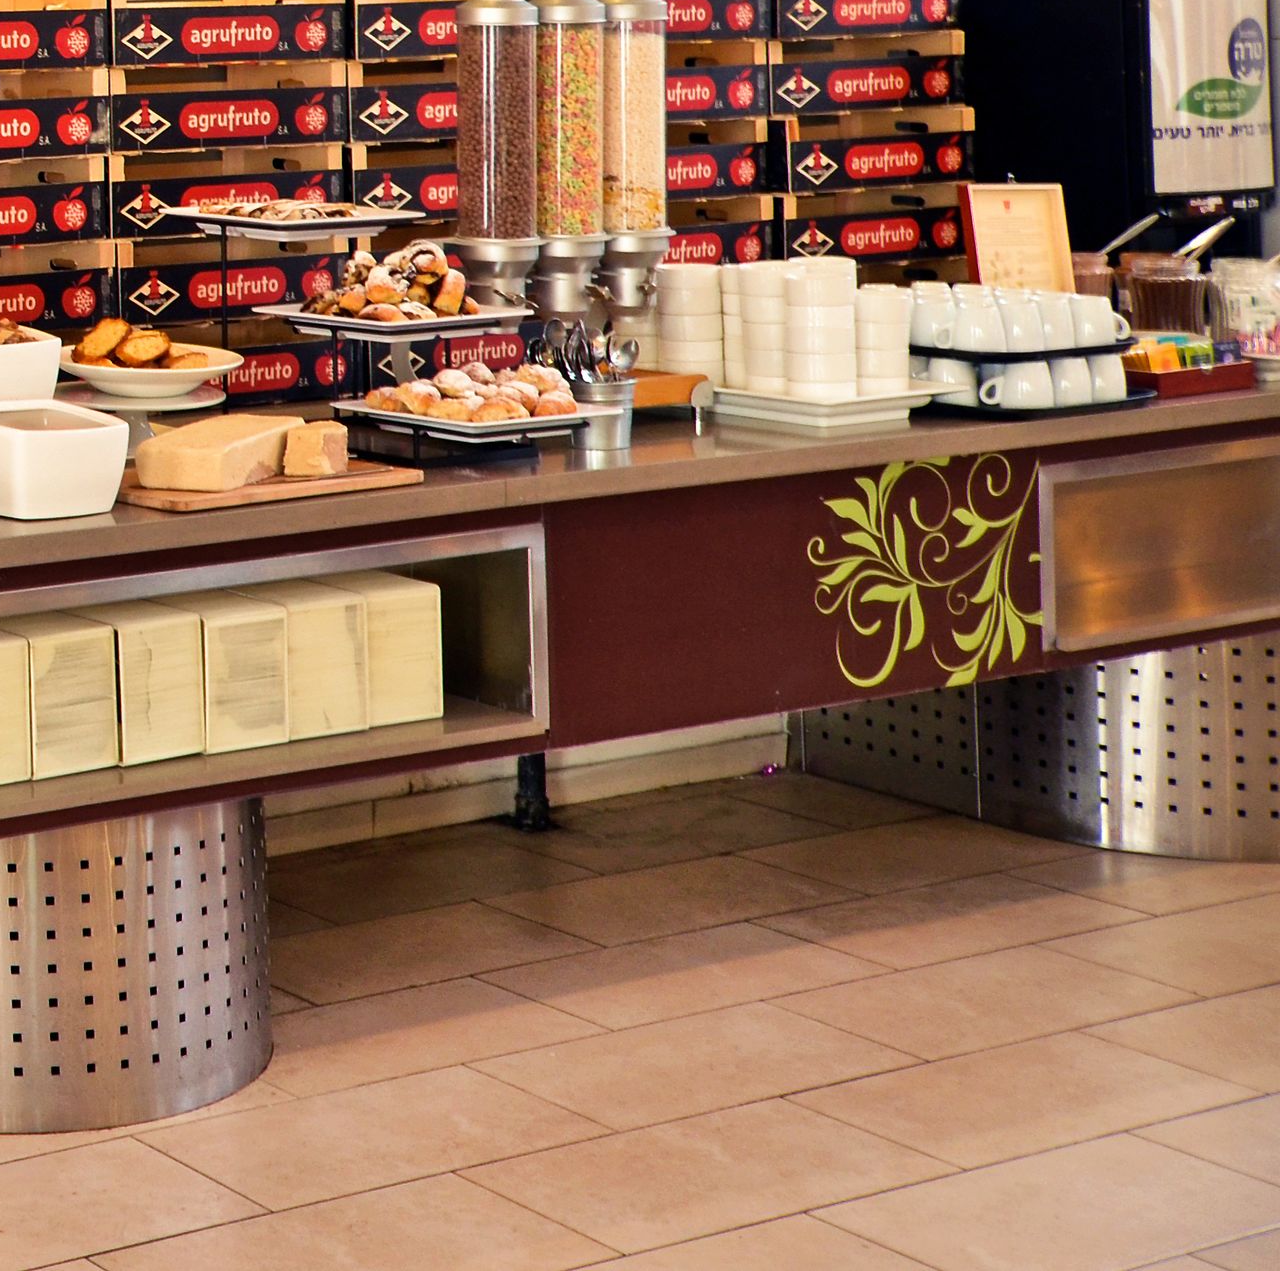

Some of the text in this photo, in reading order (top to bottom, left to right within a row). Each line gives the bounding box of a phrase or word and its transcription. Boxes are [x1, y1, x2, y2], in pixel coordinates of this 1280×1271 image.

[668, 2, 706, 27] fruto
[190, 20, 273, 48] agrufruto
[667, 81, 710, 106] ufruto
[834, 71, 904, 97] agrufruto
[188, 105, 271, 133] agrufruto
[668, 160, 712, 185] ufruto
[851, 148, 918, 173] agrufruto
[847, 224, 914, 249] agrufruto
